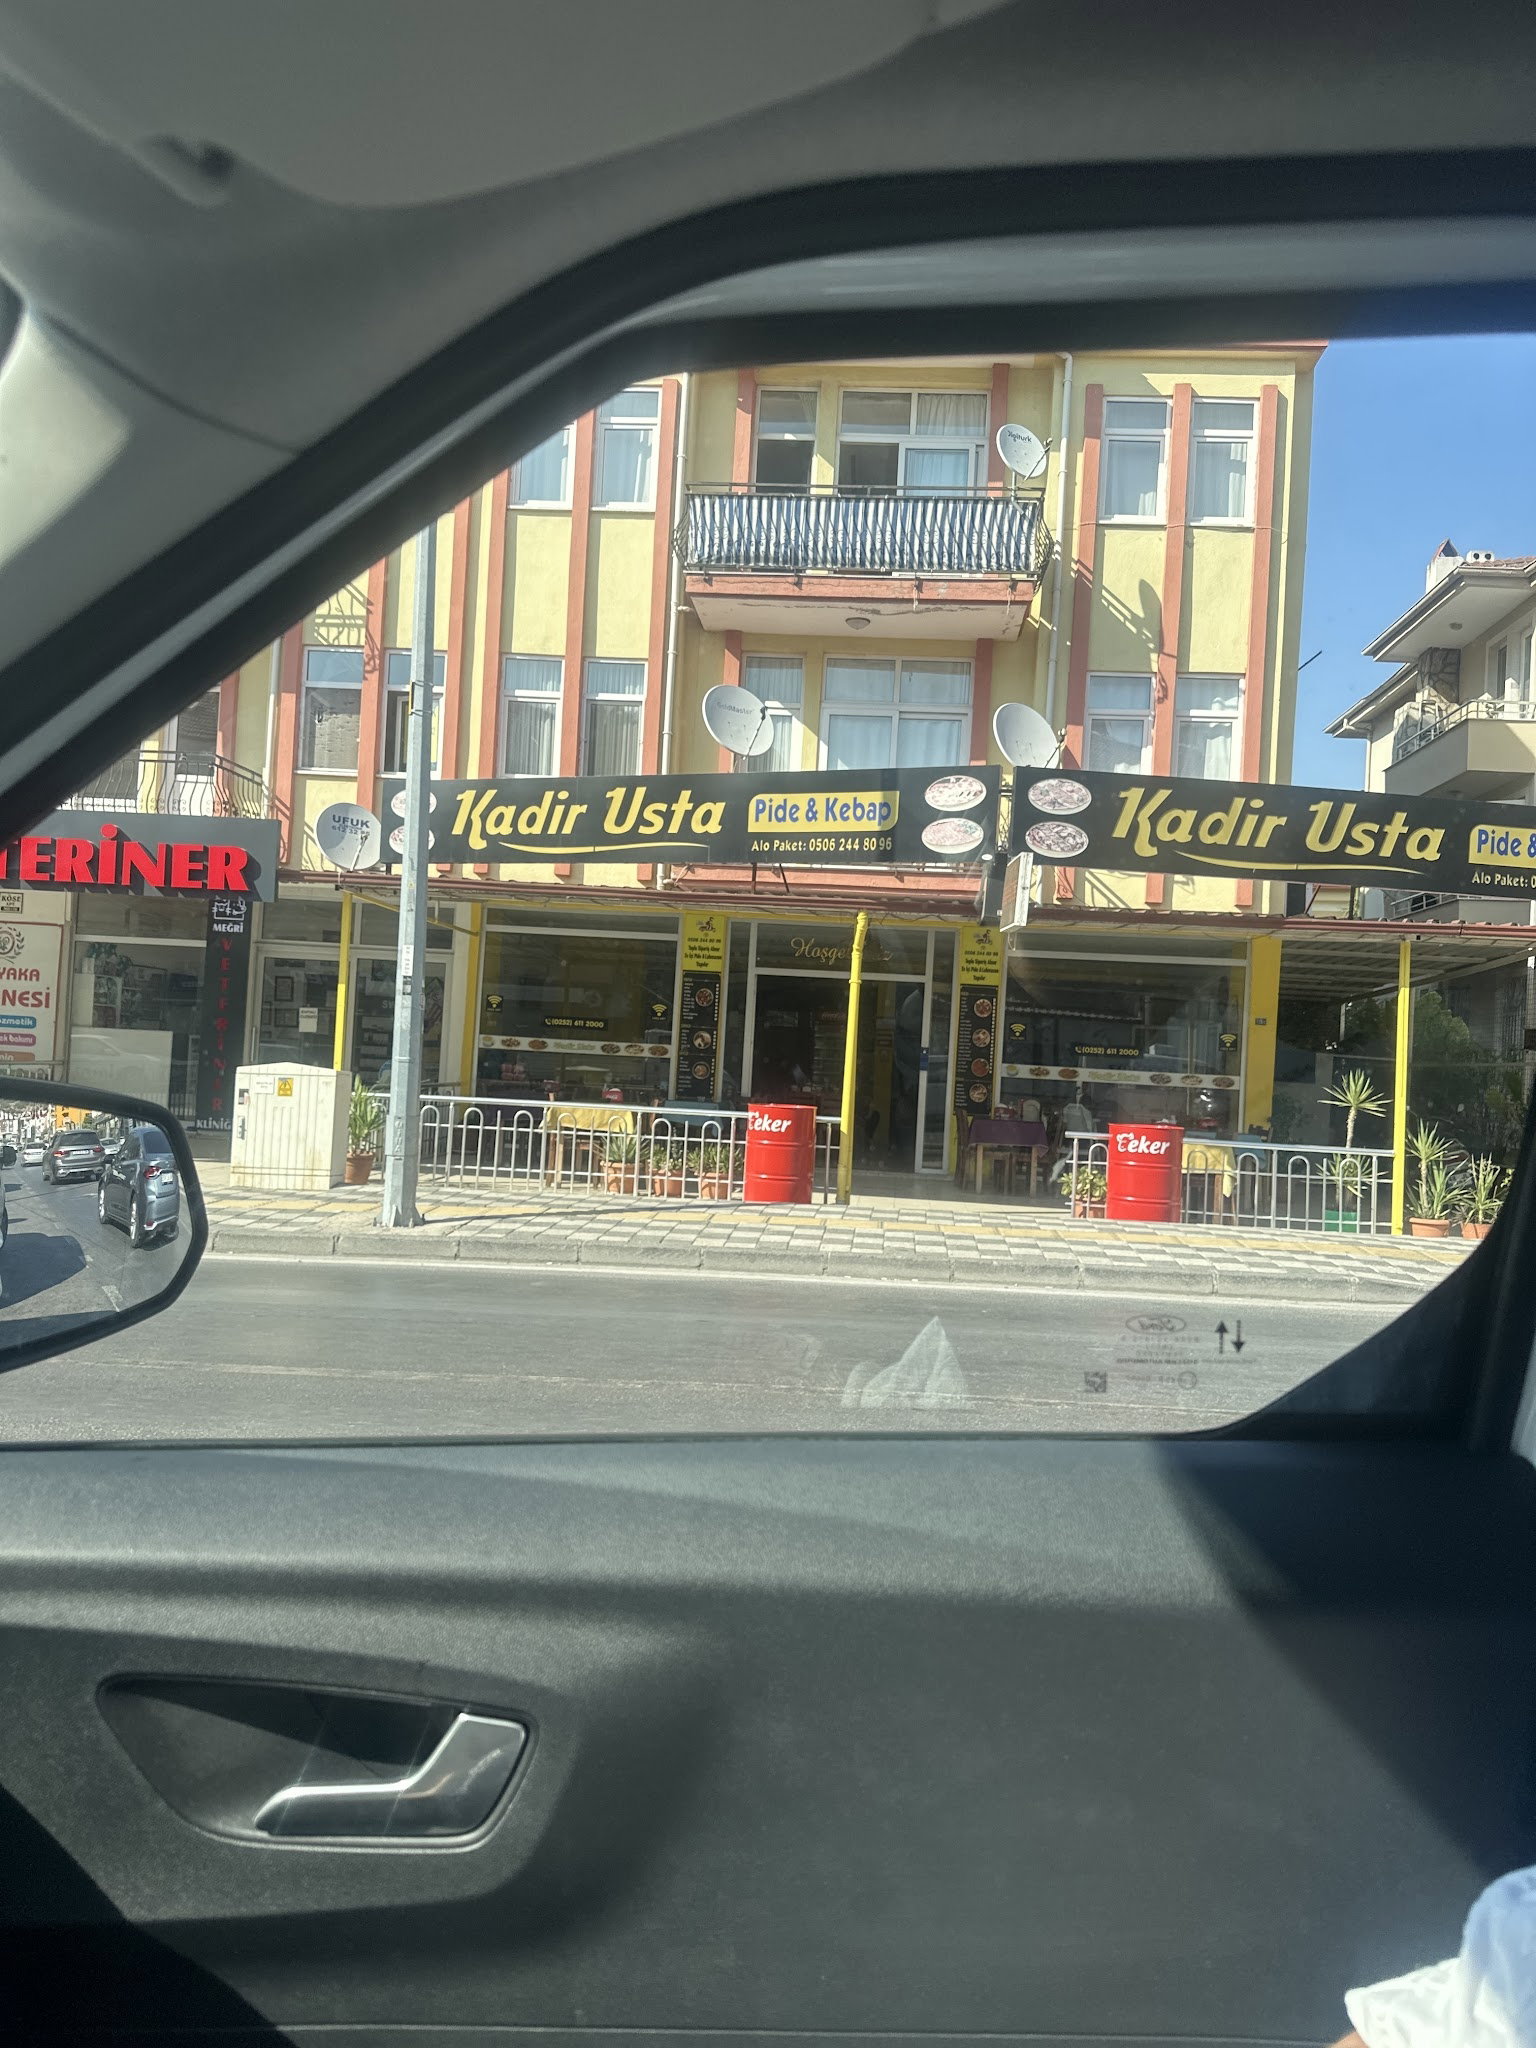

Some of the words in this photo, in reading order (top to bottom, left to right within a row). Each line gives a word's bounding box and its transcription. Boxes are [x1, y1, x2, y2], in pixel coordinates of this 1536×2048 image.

[451, 788, 587, 849] Kadir
[603, 786, 726, 835] Usta
[754, 796, 799, 823] Pide
[804, 801, 819, 823] &
[824, 795, 892, 826] Kebap
[332, 814, 371, 829] UFUK
[1111, 787, 1288, 858] Kadir
[1305, 800, 1446, 862] Usta
[751, 840, 770, 851] Alo
[773, 839, 807, 851] Paket:
[809, 838, 836, 851] 0506
[839, 838, 859, 851] 244
[863, 837, 877, 851] 80
[879, 837, 892, 851] 96
[1476, 828, 1522, 857] Pide
[1471, 871, 1491, 885] Alo
[1494, 873, 1528, 888] Paket:
[213, 922, 244, 933] MEĞRİ
[0, 1018, 33, 1026] zmetik
[552, 1018, 573, 1027] (0252)
[586, 1020, 604, 1029] 2000
[1082, 1046, 1105, 1055] (0252)
[1106, 1047, 1117, 1055] 611
[1119, 1048, 1139, 1056] 2000
